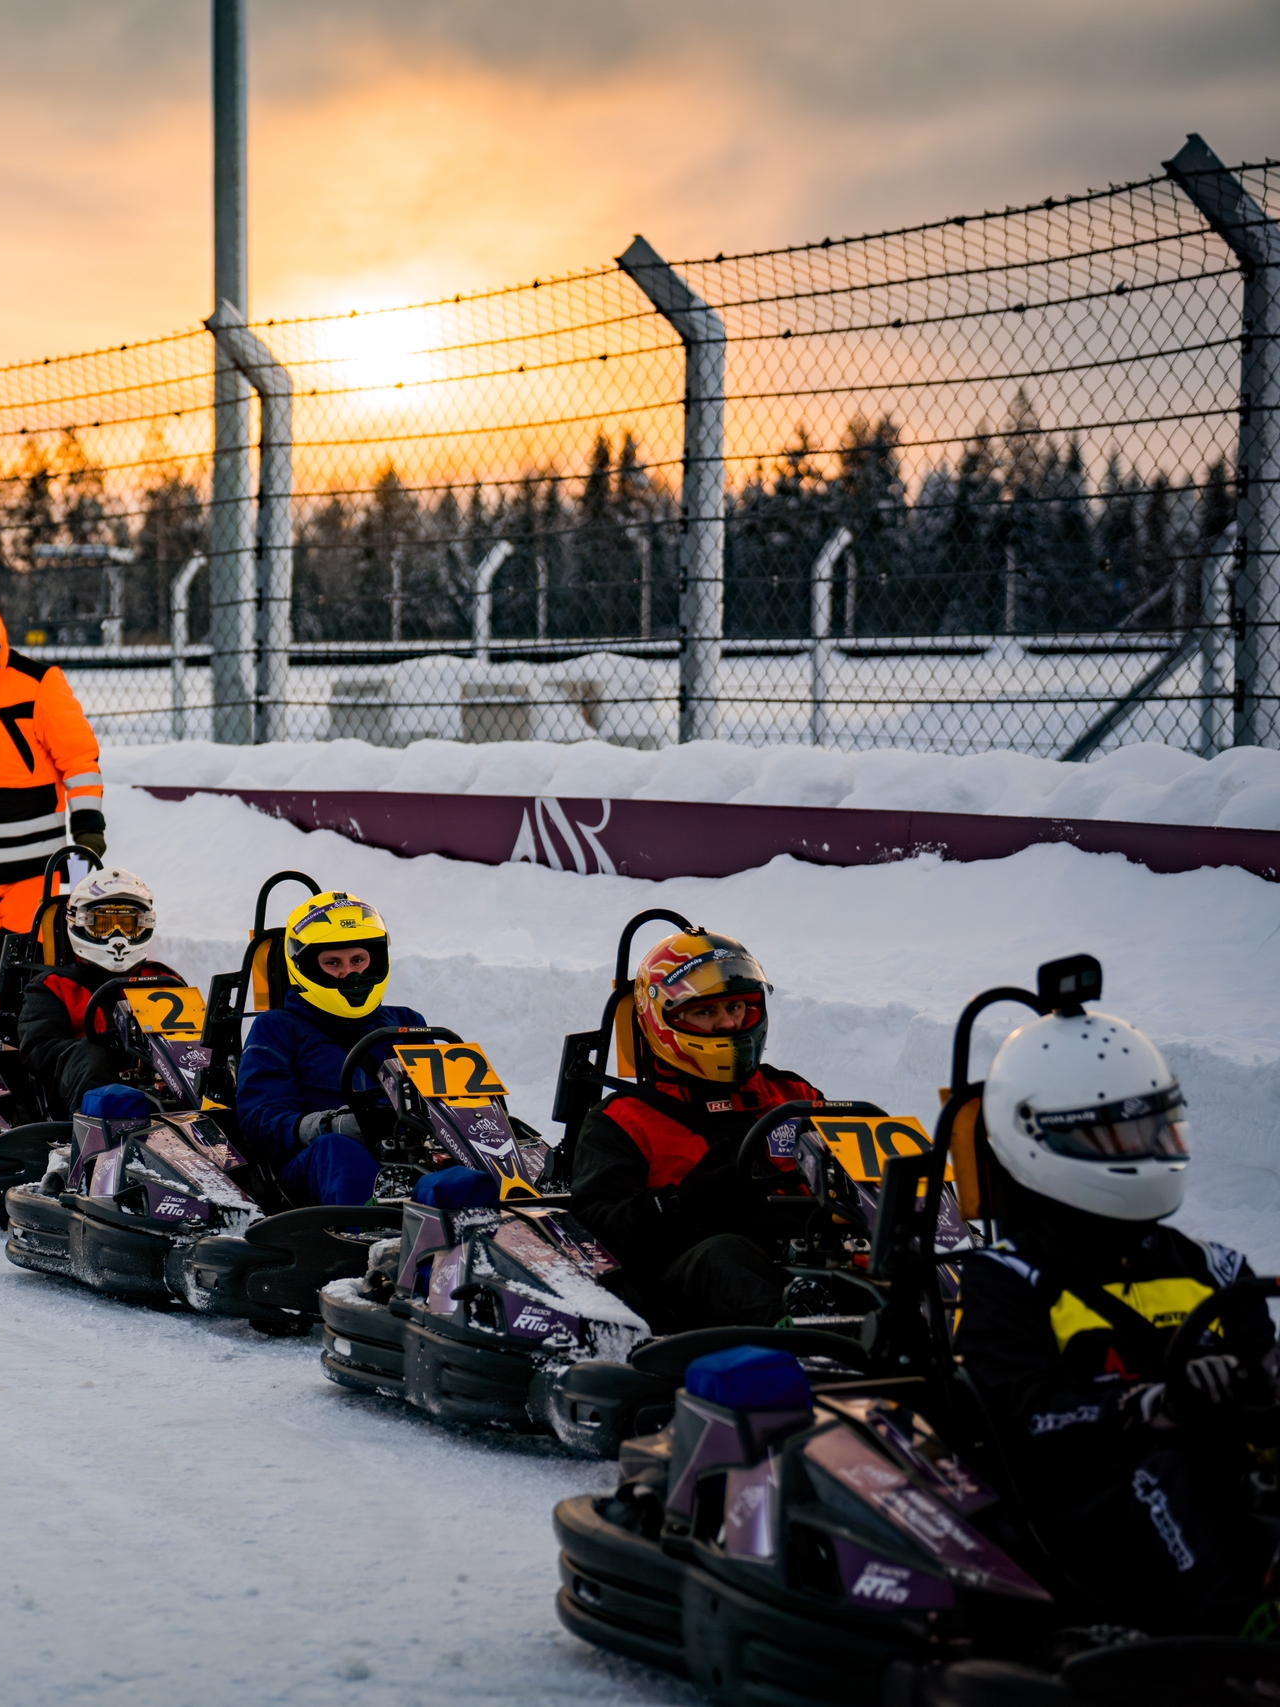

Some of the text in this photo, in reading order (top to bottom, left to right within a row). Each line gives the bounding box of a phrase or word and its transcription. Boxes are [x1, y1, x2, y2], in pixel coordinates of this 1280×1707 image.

[147, 991, 195, 1030] 2
[398, 1047, 506, 1095] 72
[439, 1127, 478, 1171] #IGORADRIV
[818, 1121, 935, 1178] 70
[531, 1307, 552, 1317] SODI
